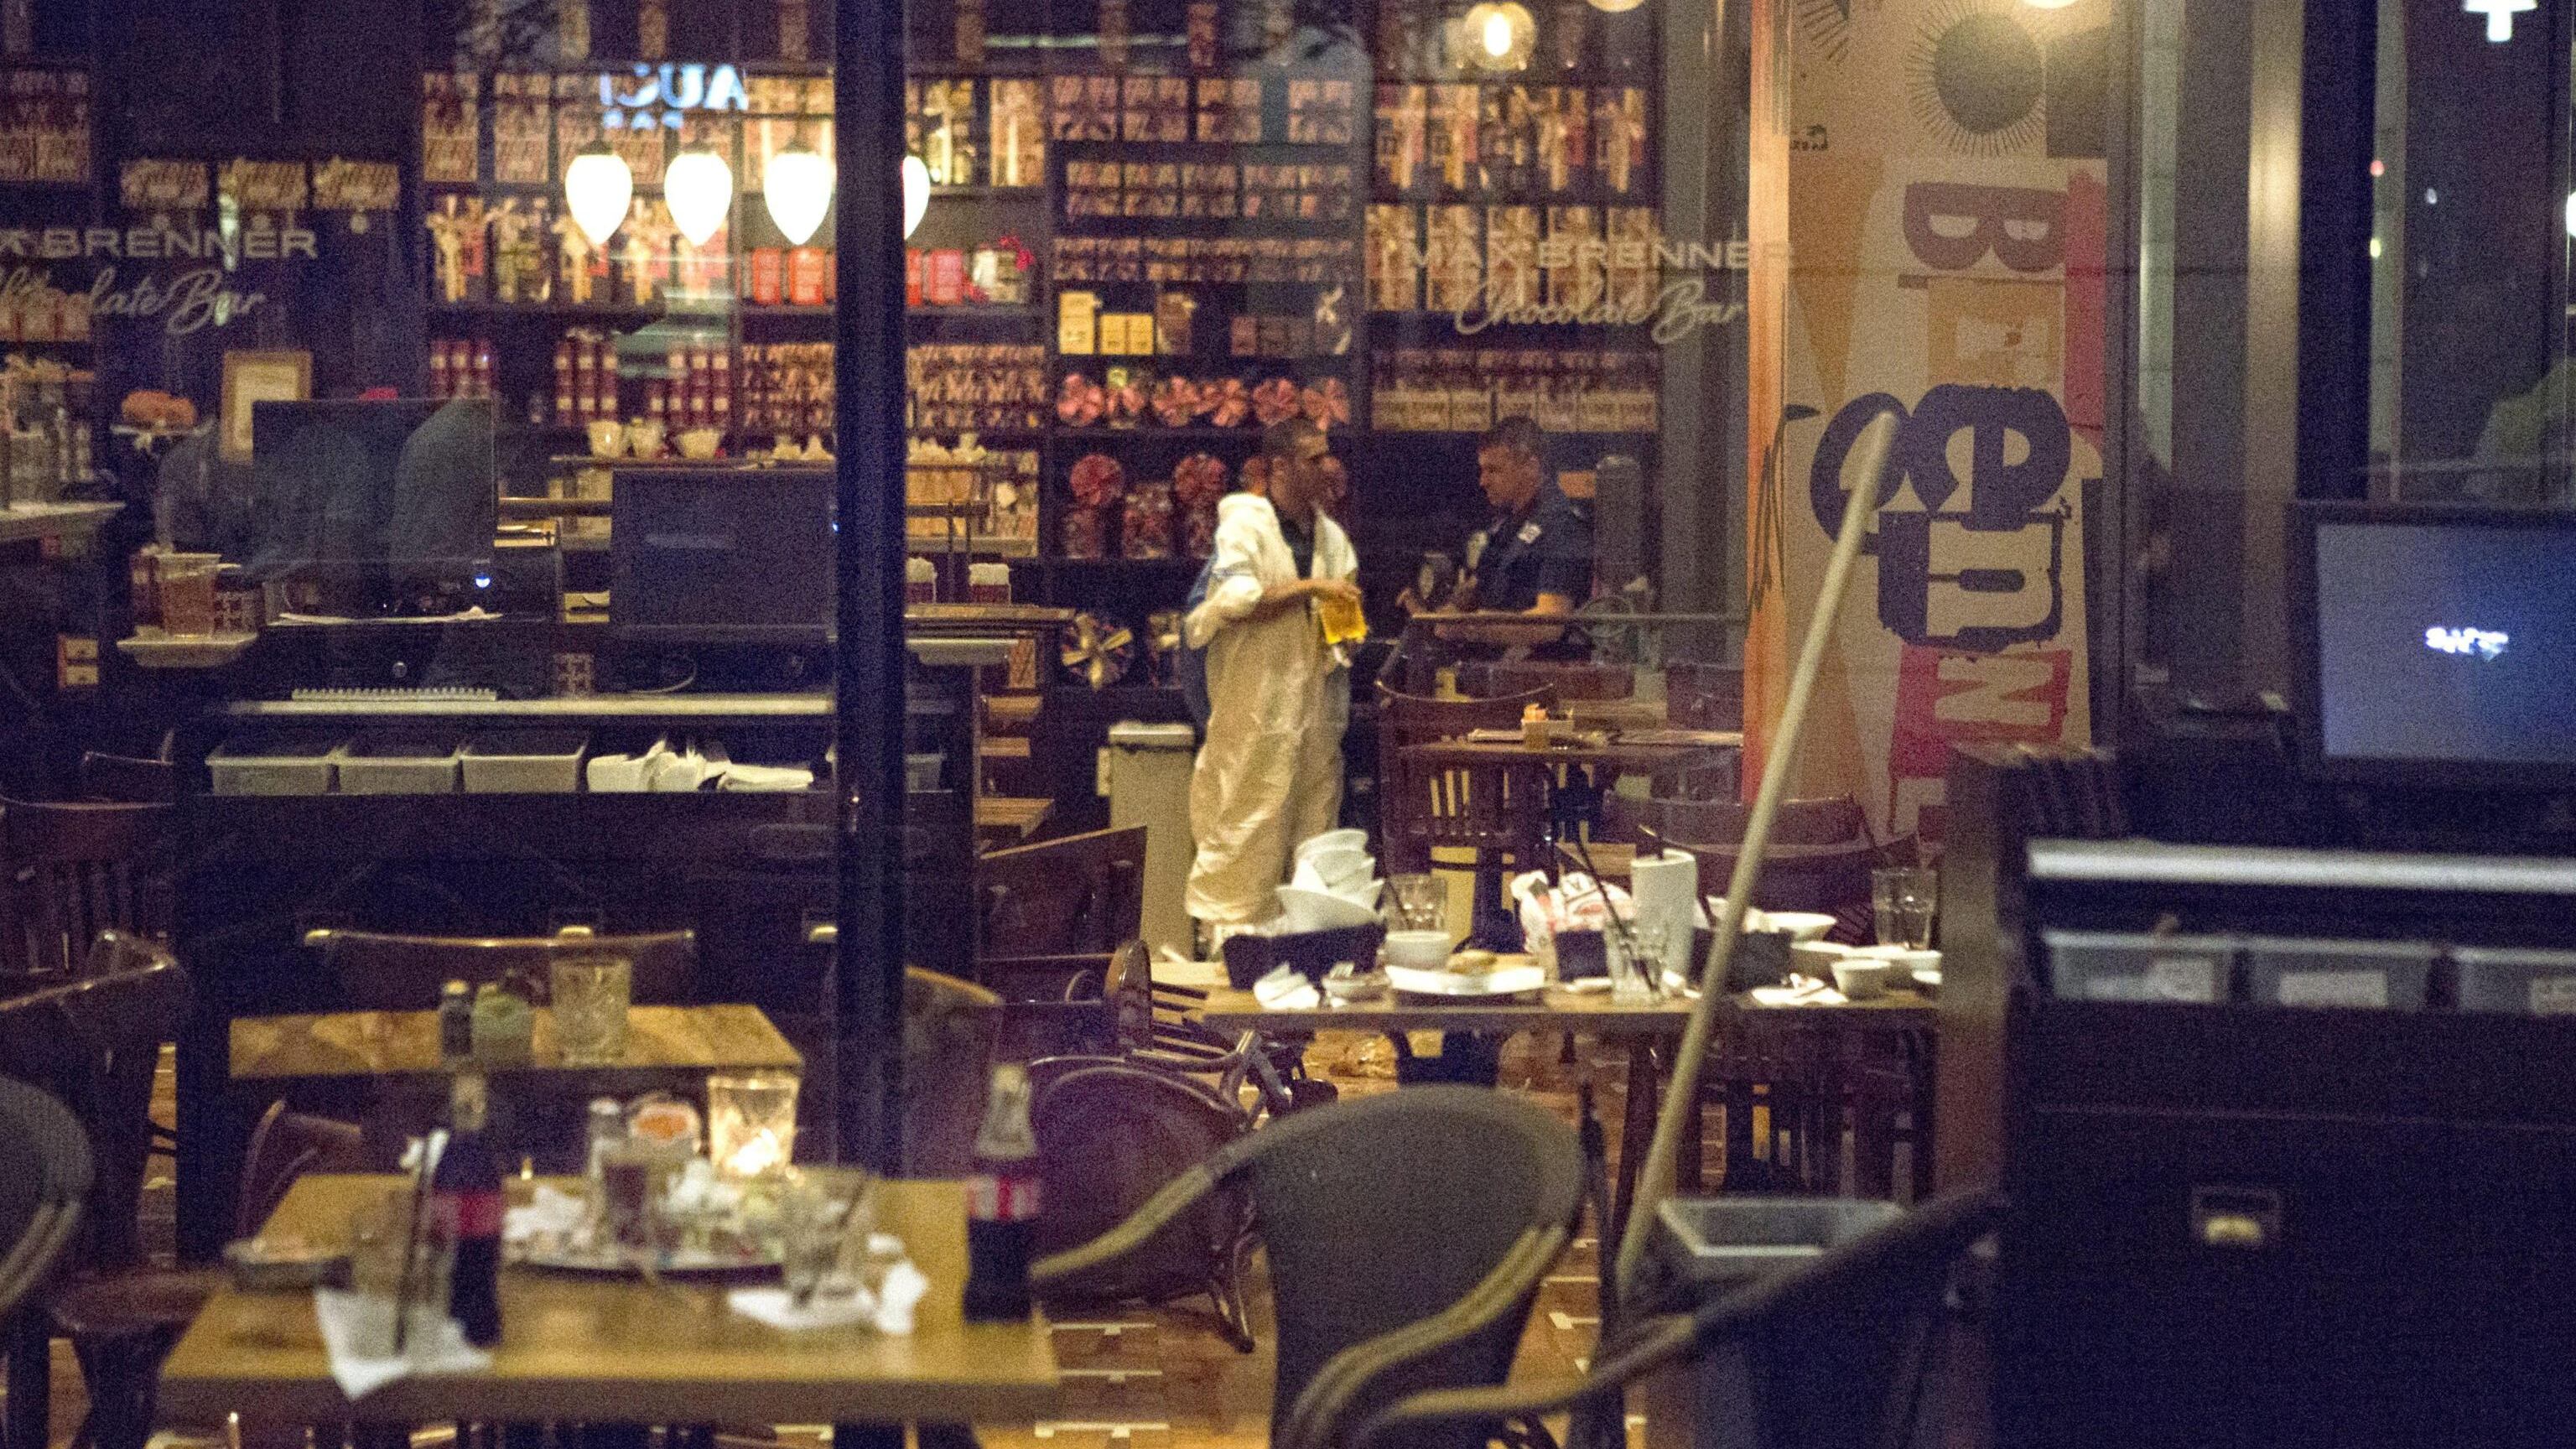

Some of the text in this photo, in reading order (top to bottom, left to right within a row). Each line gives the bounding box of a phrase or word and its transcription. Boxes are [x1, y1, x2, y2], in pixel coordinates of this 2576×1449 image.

[42, 227, 319, 258] BRENNER
[165, 267, 267, 335] Bar
[1649, 278, 1746, 345] Bar
